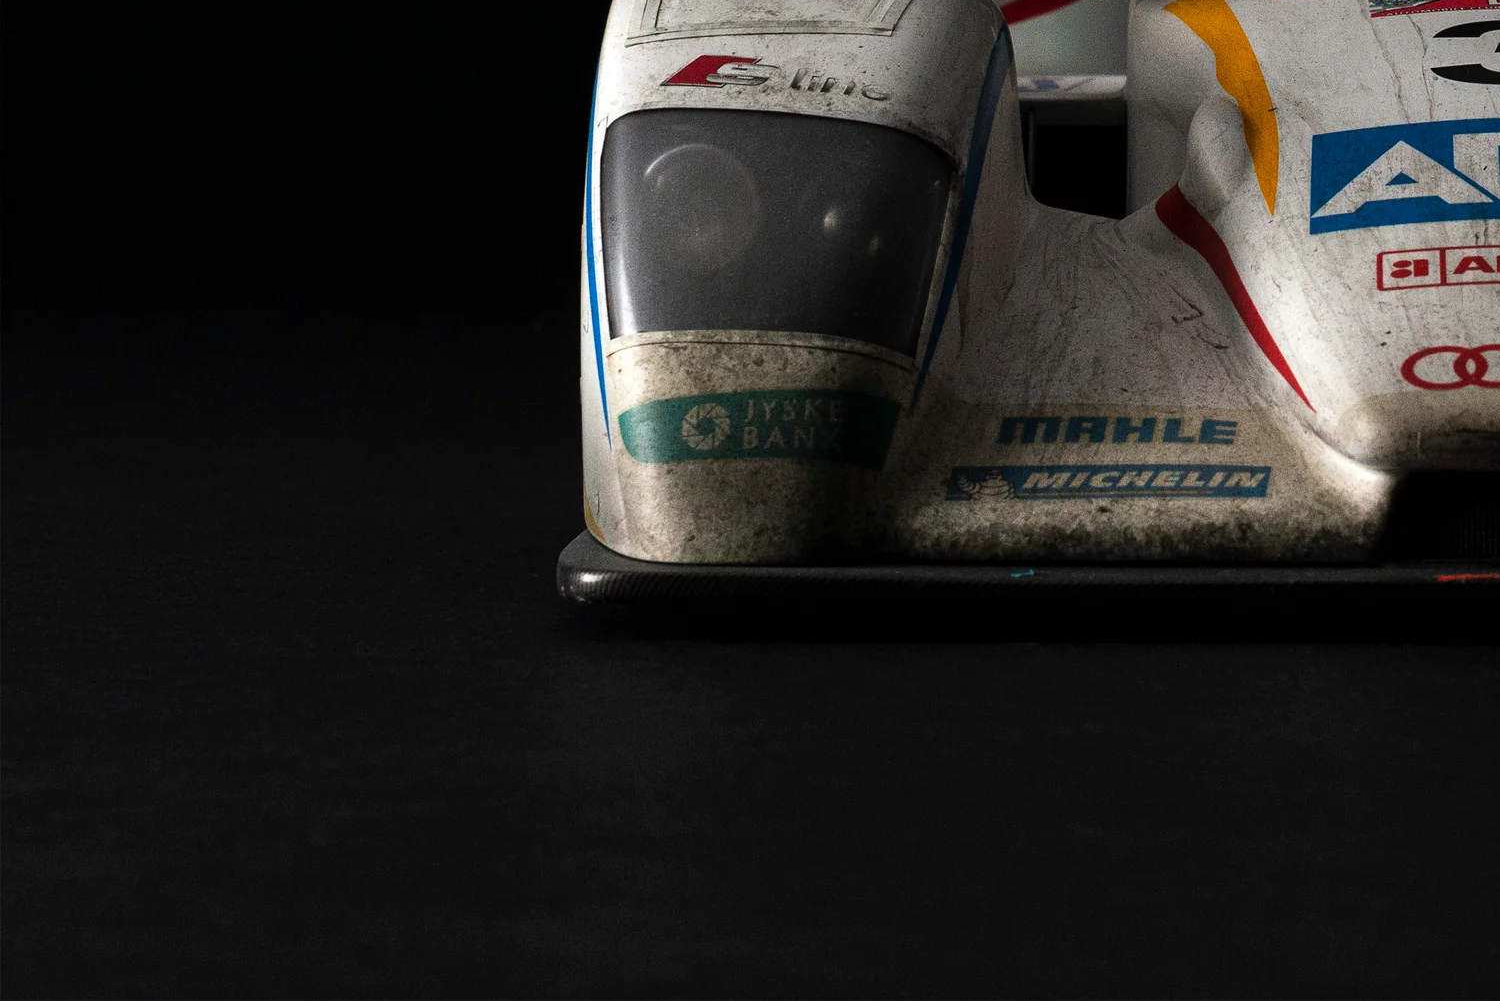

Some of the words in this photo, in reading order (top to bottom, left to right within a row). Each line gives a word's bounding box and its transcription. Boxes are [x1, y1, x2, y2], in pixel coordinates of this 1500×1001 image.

[744, 398, 845, 423] JYSKE
[742, 426, 845, 451] BANK
[997, 416, 1238, 445] MAHLE
[1020, 469, 1269, 489] MICHELIN
